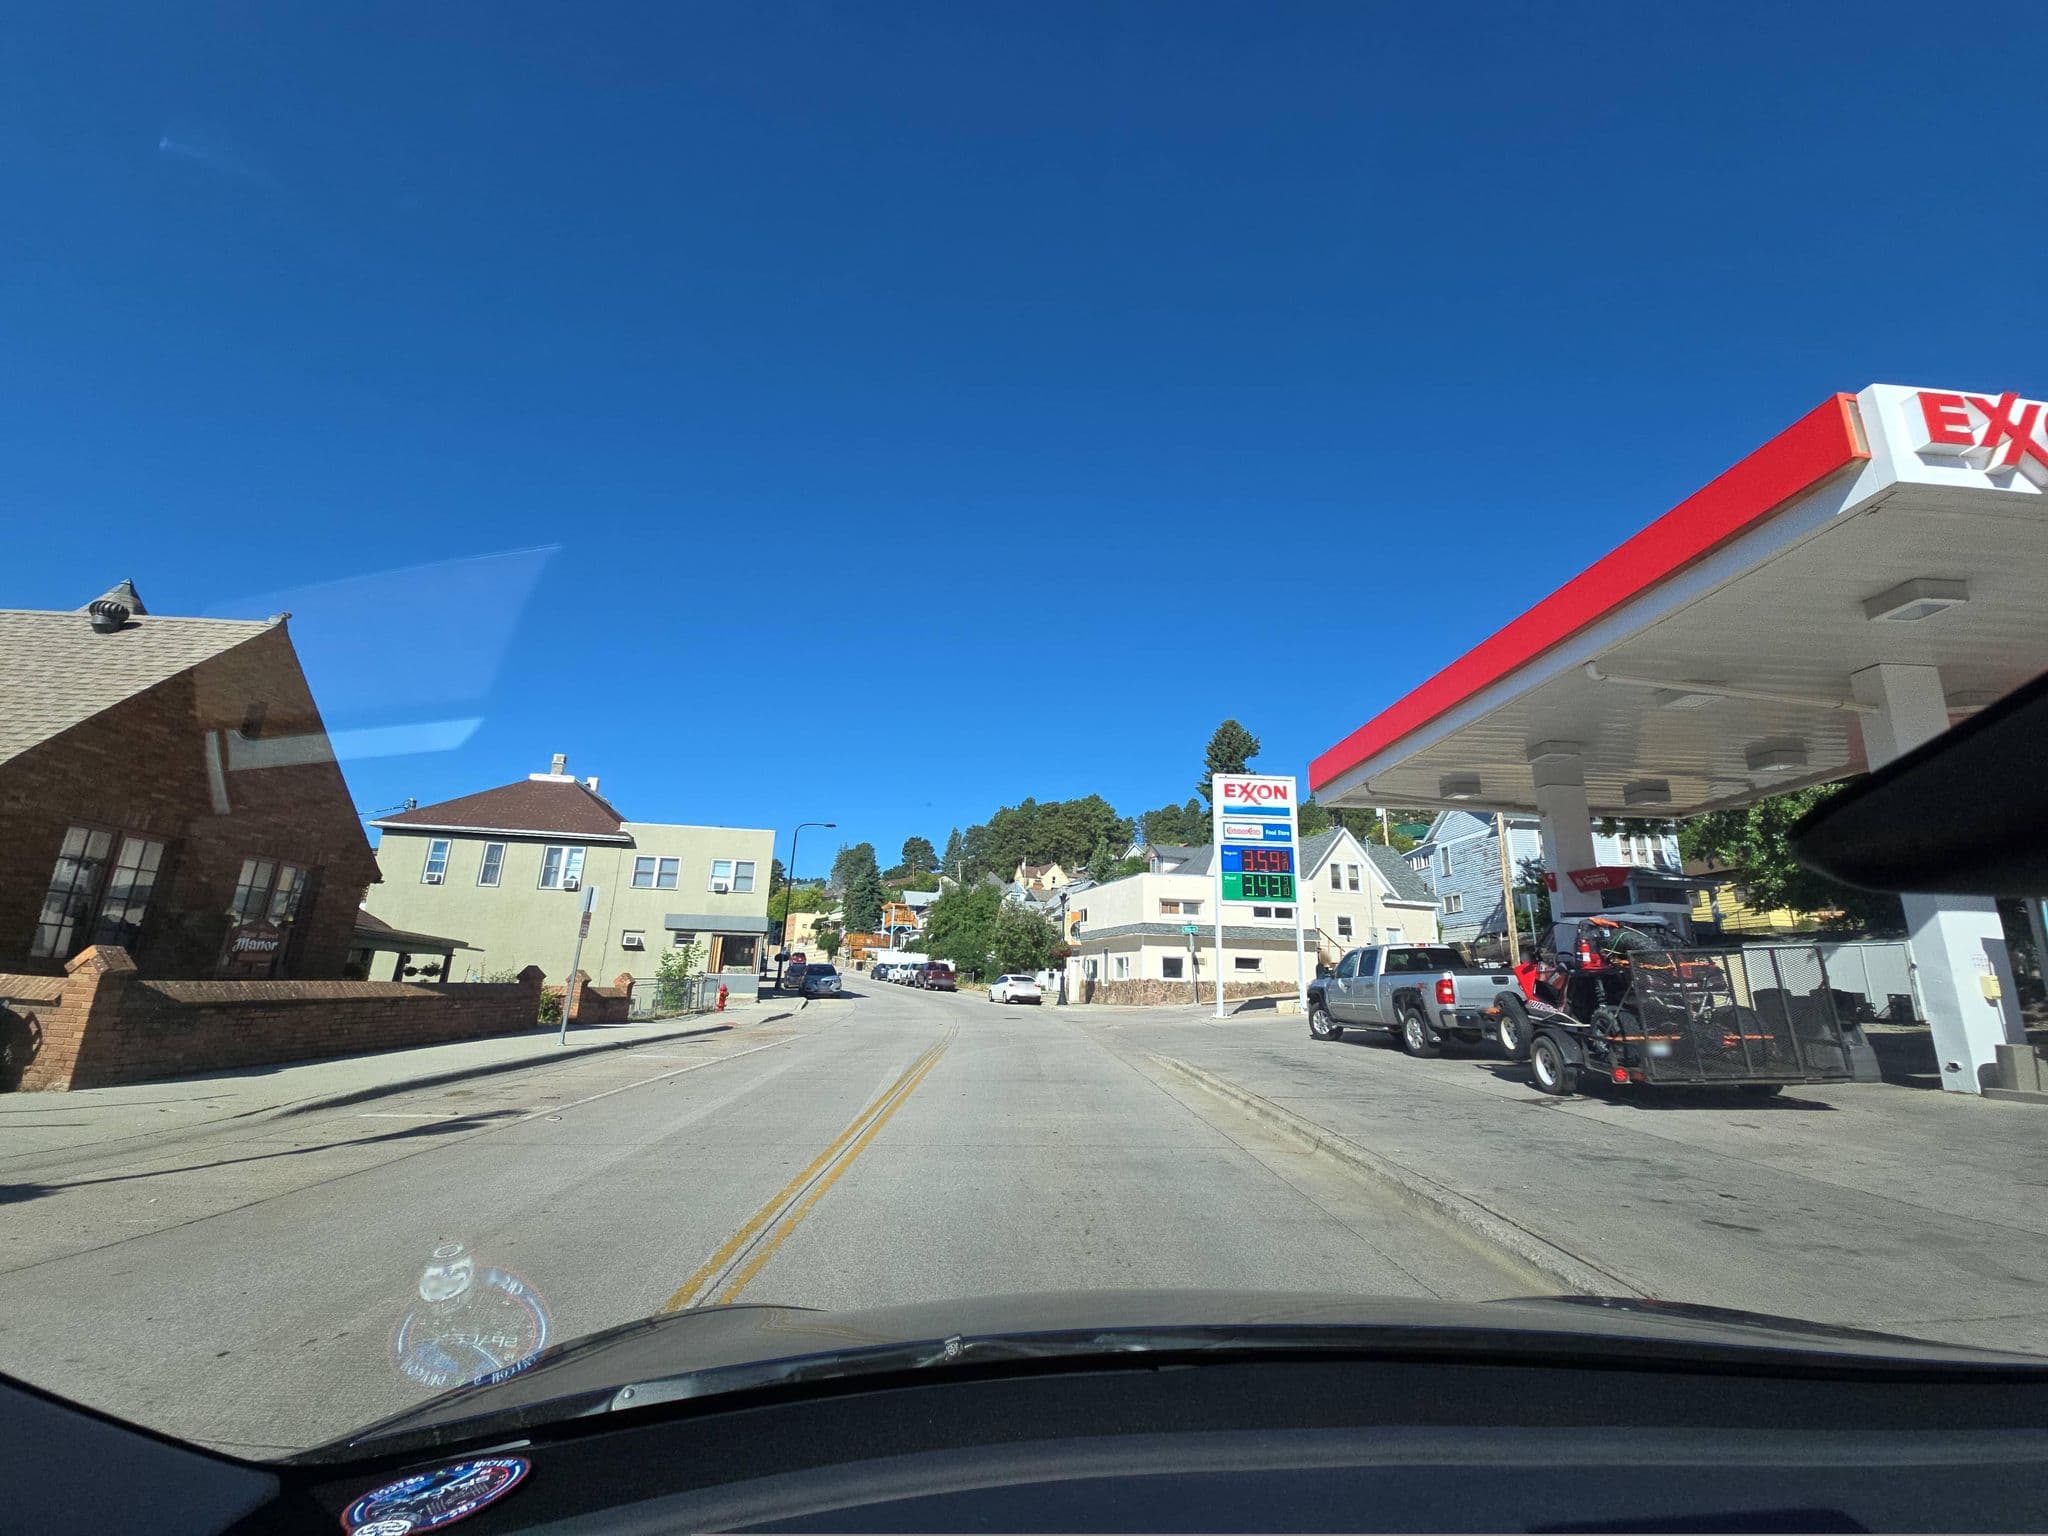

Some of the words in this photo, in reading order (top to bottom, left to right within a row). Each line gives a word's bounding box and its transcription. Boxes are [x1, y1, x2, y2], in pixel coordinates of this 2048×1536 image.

[1224, 782, 1288, 805] EXXON
[1244, 850, 1280, 872] 3.59
[1244, 875, 1281, 897] 3.43
[232, 937, 279, 952] Manor
